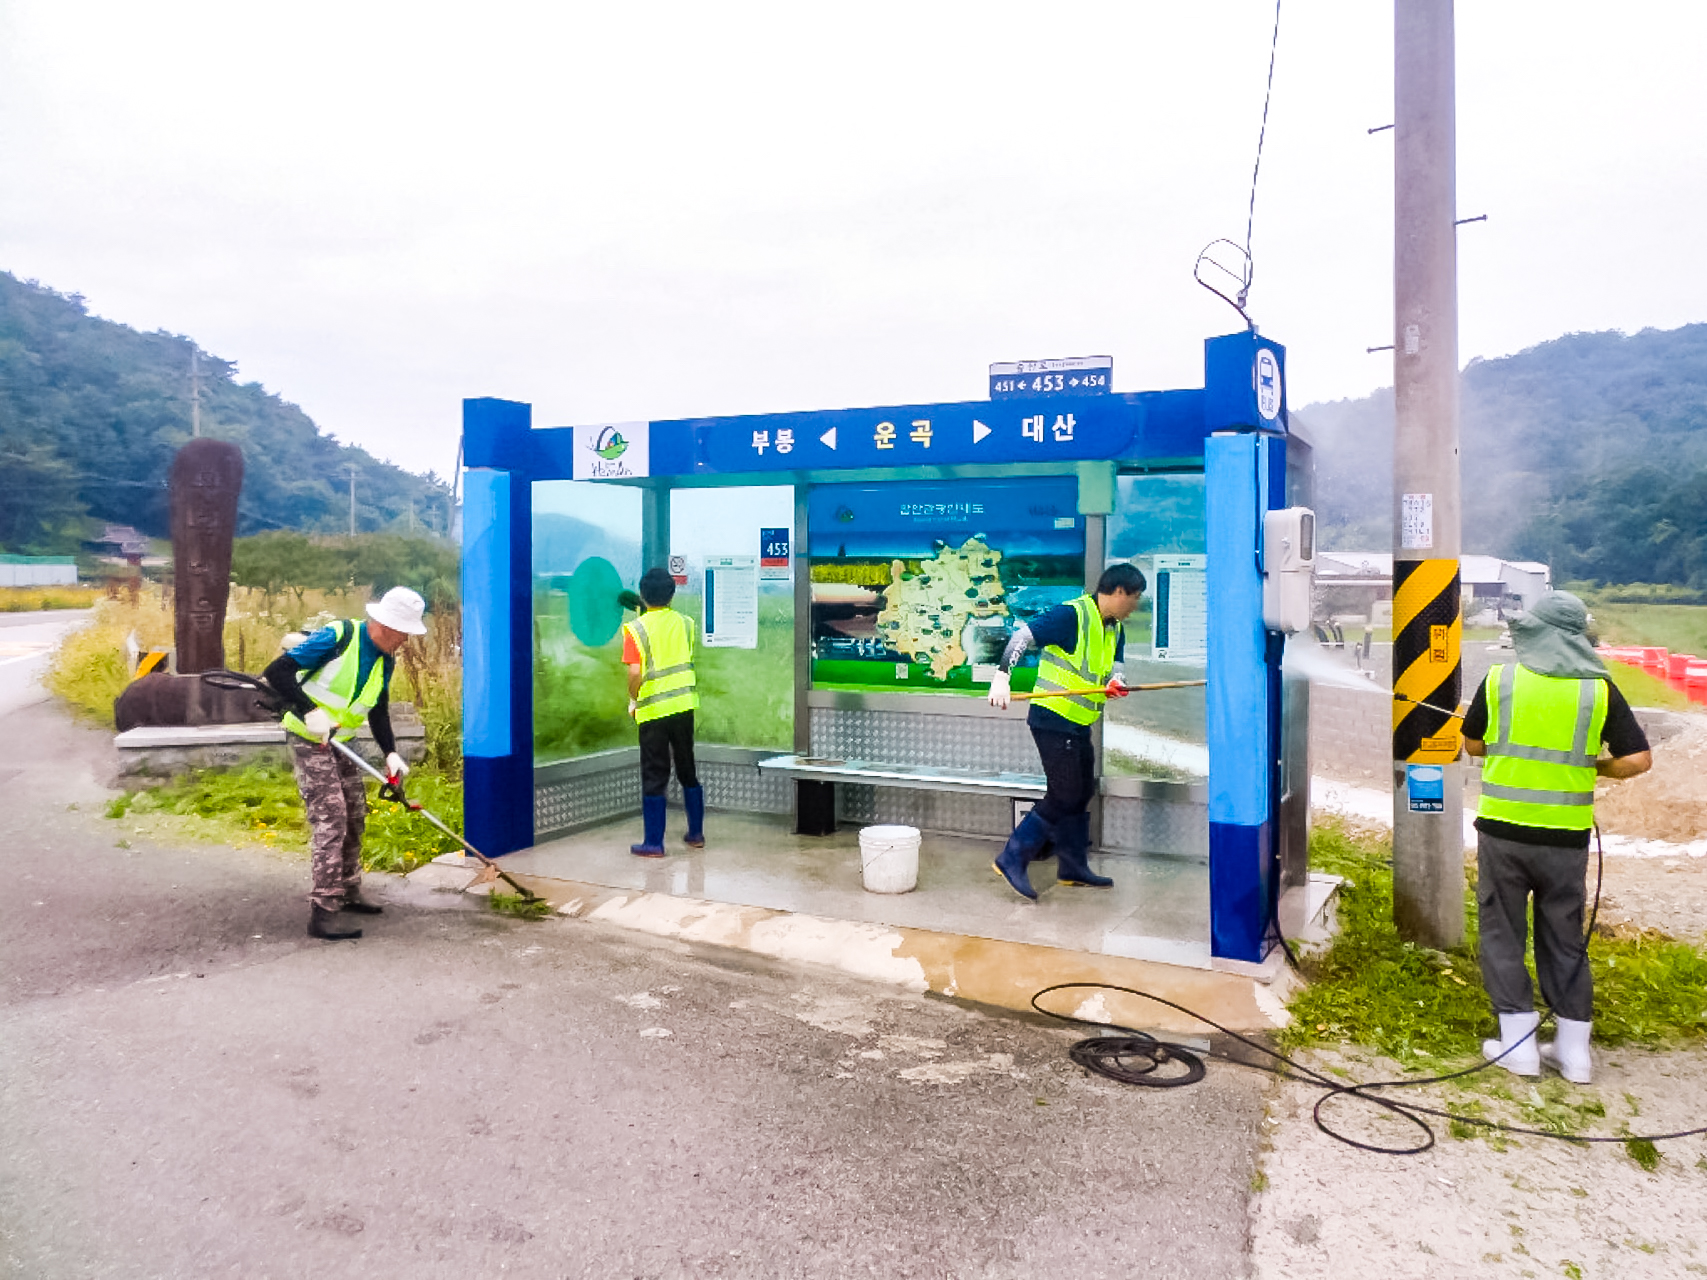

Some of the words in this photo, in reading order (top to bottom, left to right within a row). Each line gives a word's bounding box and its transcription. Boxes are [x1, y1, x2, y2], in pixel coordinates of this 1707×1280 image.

[994, 381, 1014, 392] 451
[1032, 375, 1064, 392] 453
[1081, 375, 1106, 387] 454
[751, 428, 795, 455] 부봉
[873, 420, 933, 450] 운곡
[1021, 413, 1077, 443] 대산
[766, 542, 789, 556] 453
